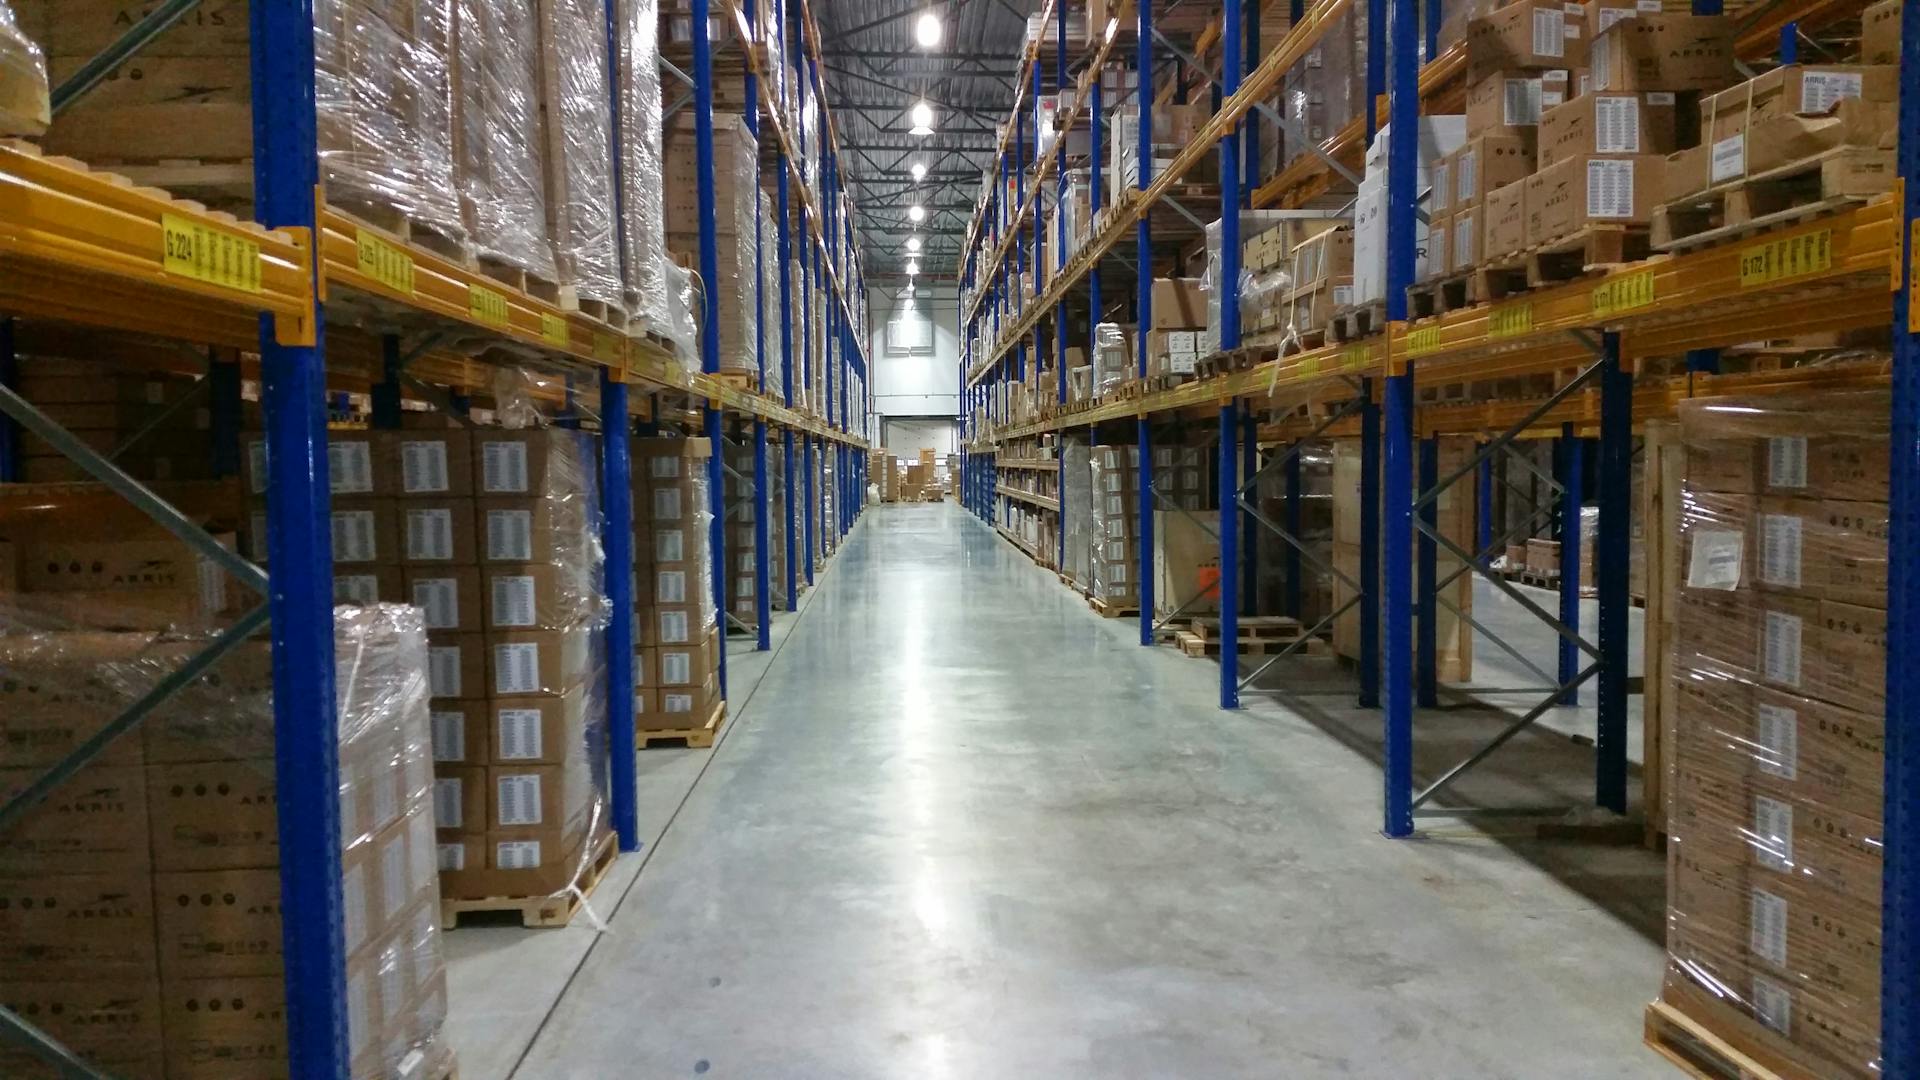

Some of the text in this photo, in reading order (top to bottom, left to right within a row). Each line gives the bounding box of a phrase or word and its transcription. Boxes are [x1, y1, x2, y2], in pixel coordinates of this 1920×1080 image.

[1557, 129, 1583, 145] ARRIS
[1545, 191, 1569, 208] ARRIS
[166, 229, 192, 260] G 224
[1742, 257, 1749, 276] G
[113, 574, 176, 584] ARRIS
